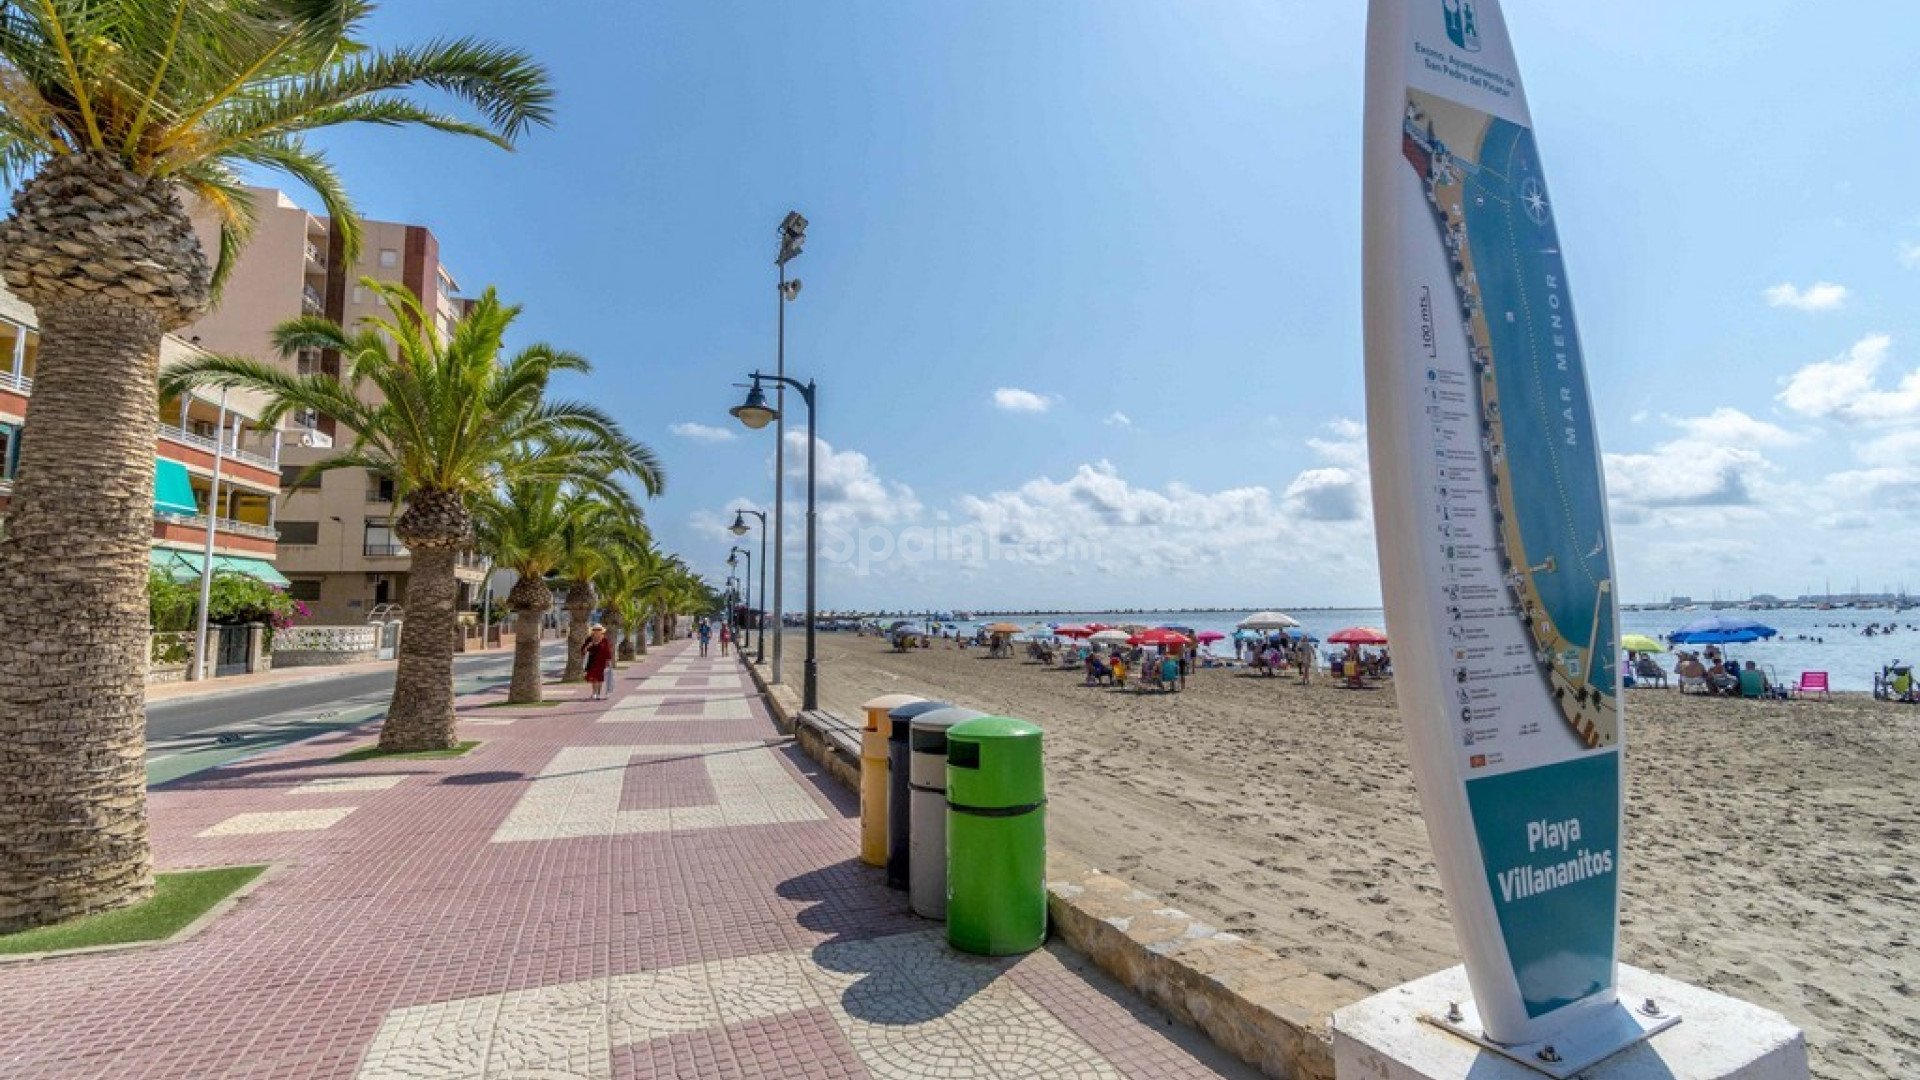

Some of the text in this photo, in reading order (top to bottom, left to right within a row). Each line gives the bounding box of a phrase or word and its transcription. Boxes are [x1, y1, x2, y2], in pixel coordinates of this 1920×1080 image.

[1425, 58, 1442, 72] San
[1443, 64, 1468, 83] Pedro
[1469, 75, 1481, 86] del
[1422, 324, 1432, 348] 100
[1546, 274, 1576, 446] MAR MENOR
[1527, 817, 1581, 852] Playa
[1497, 848, 1613, 903] Villananitos
